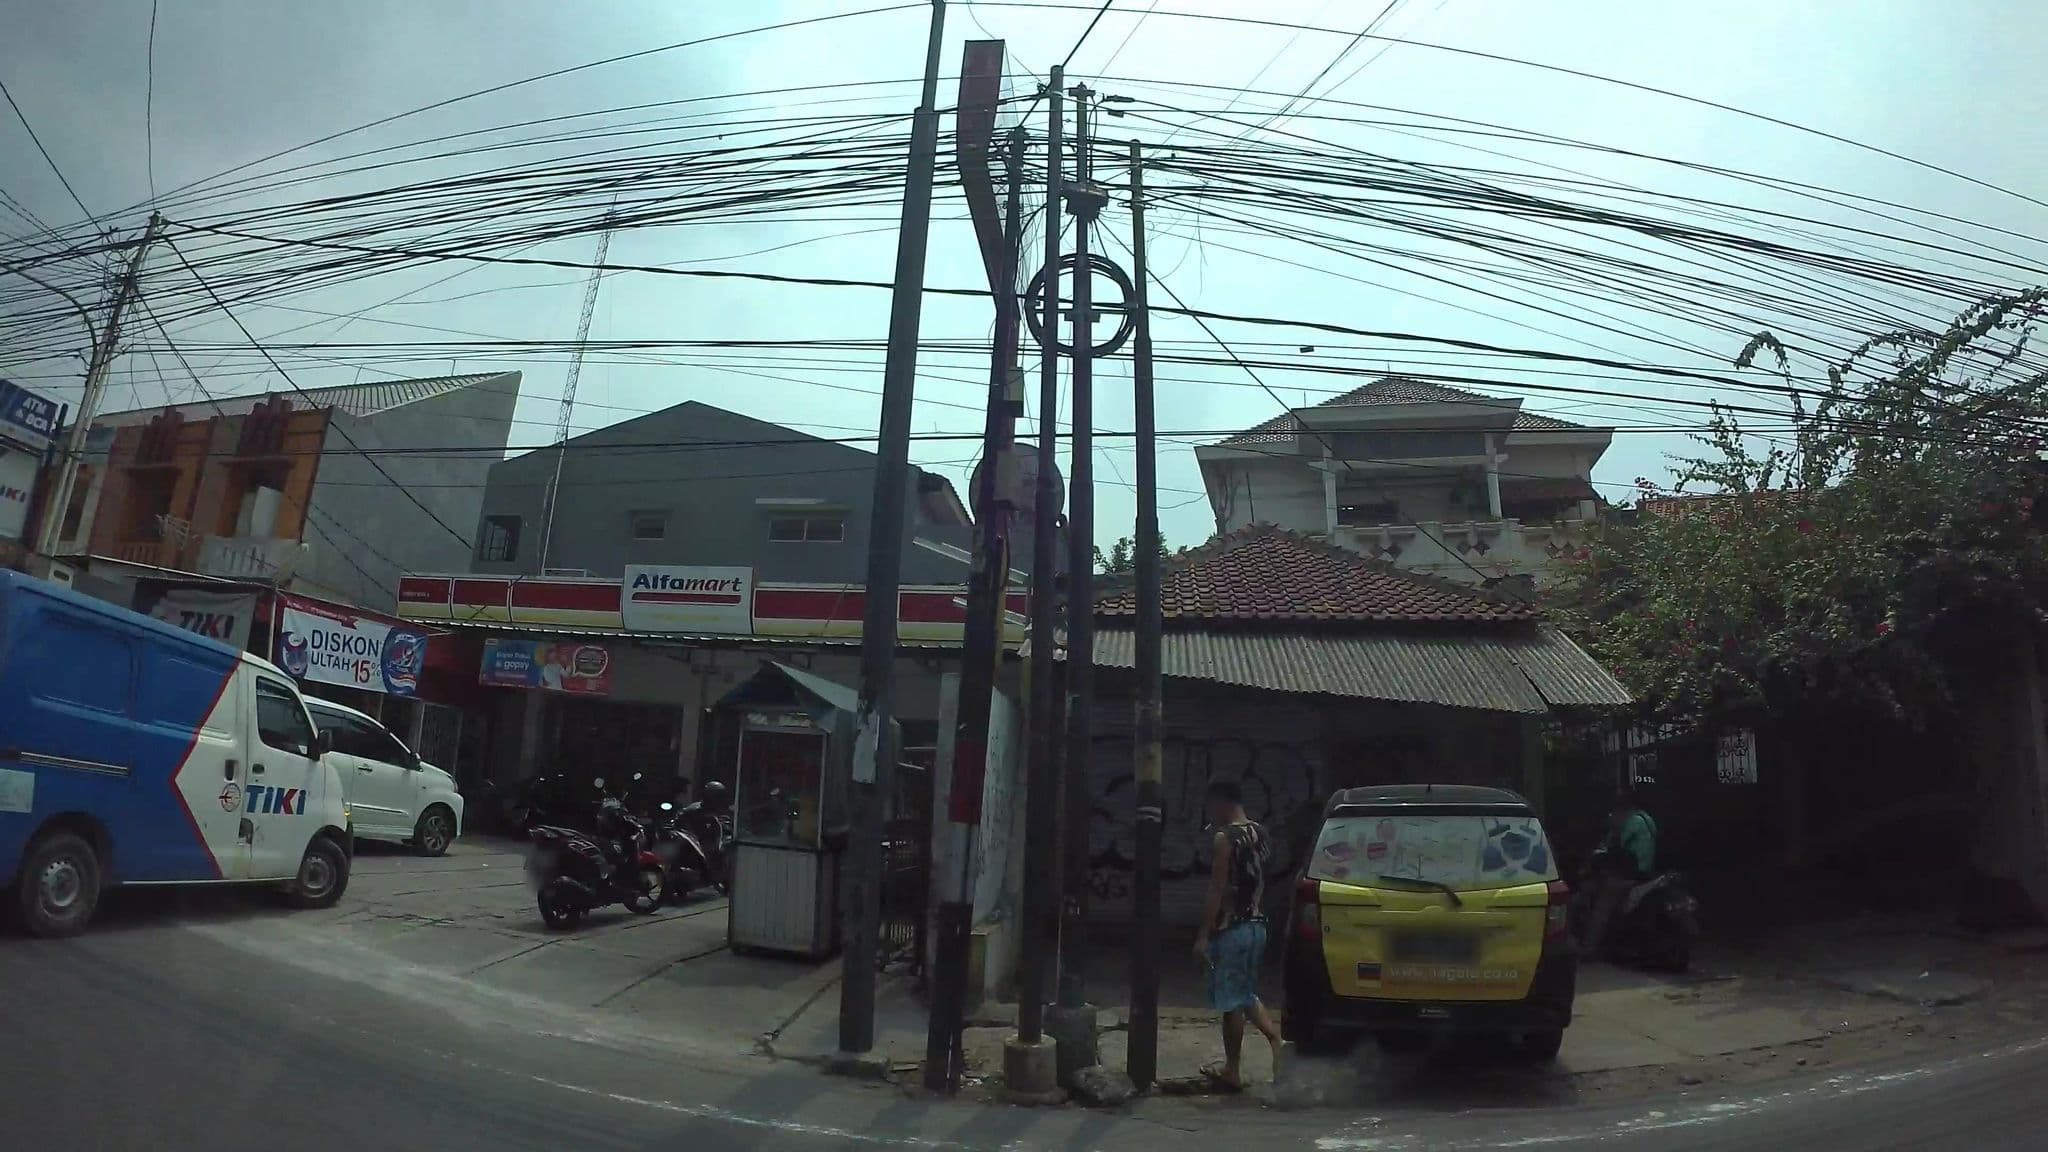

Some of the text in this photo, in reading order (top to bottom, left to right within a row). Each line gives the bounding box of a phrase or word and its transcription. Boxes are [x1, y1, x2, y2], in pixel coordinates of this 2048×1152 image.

[632, 573, 742, 592] Alfamart
[311, 629, 379, 657] DISKON
[311, 651, 350, 672] ULTAH
